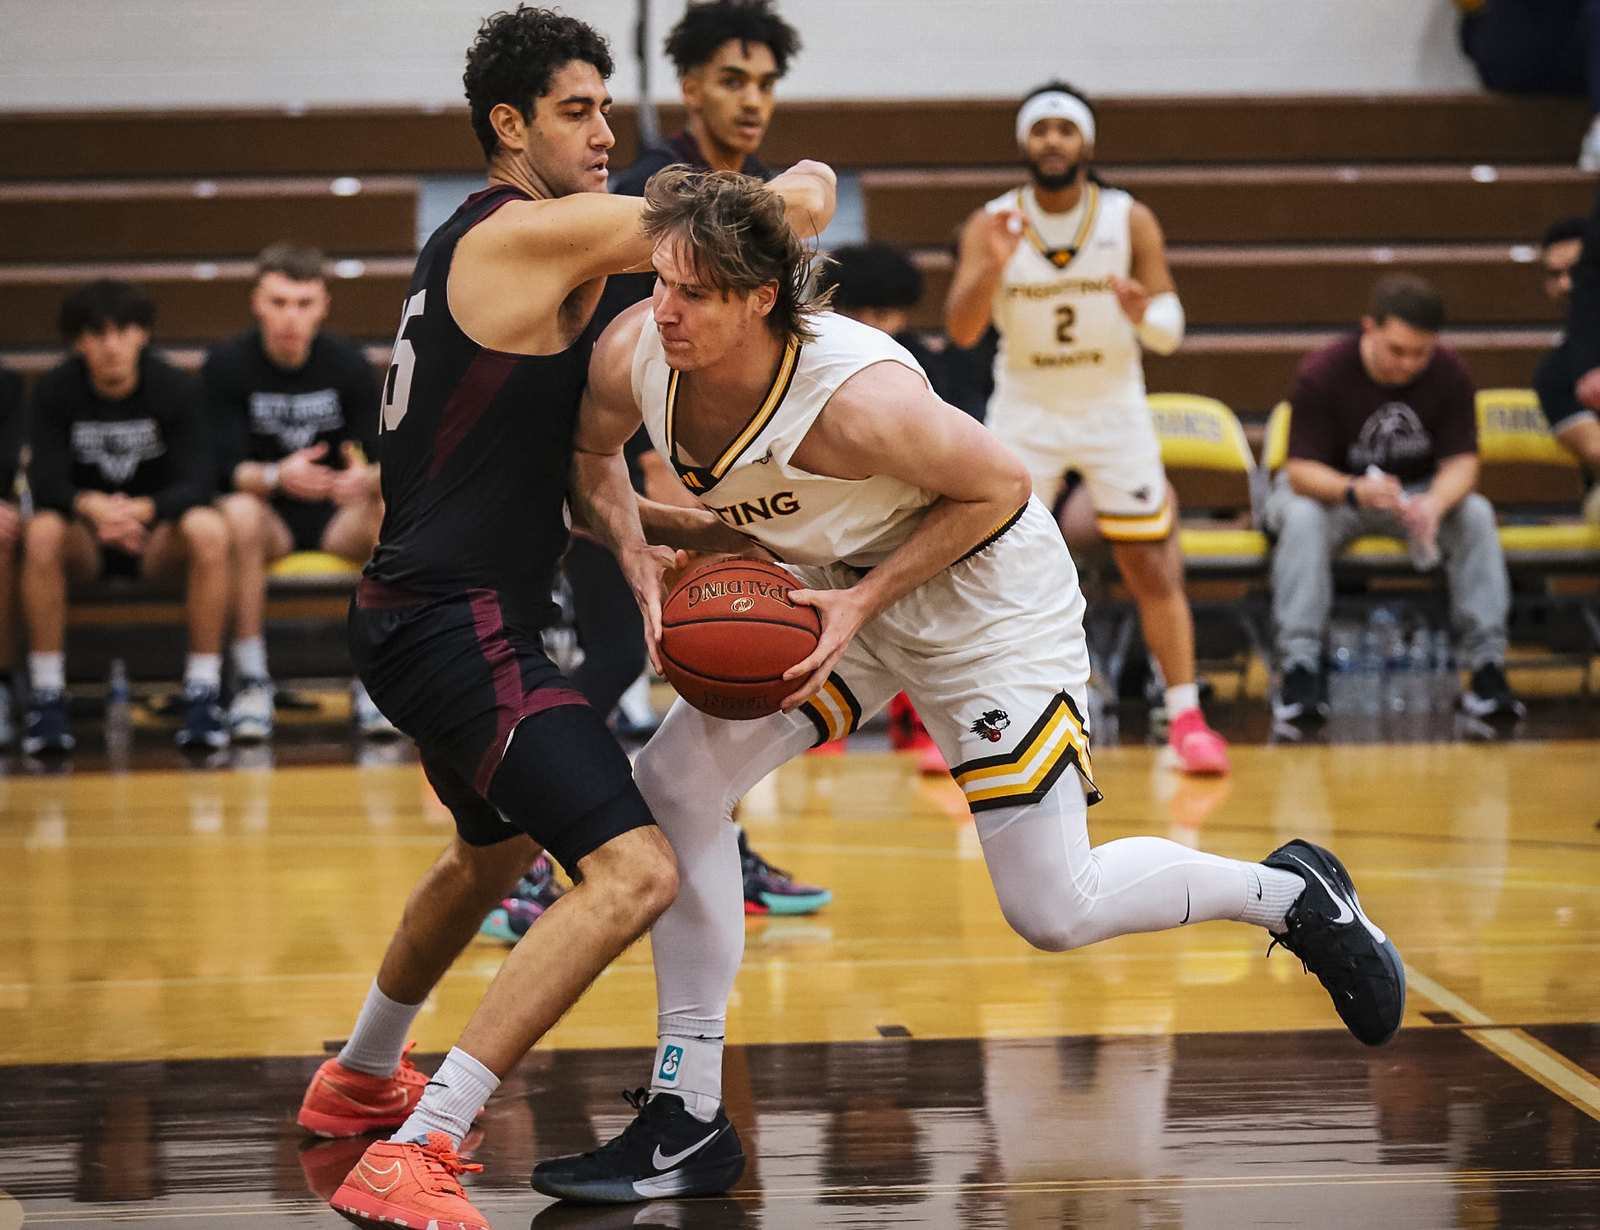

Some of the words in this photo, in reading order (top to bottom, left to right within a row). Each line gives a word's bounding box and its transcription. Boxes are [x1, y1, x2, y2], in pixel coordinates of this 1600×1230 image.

[1055, 305, 1076, 344] 2
[379, 289, 427, 435] 5
[708, 491, 801, 526] TING
